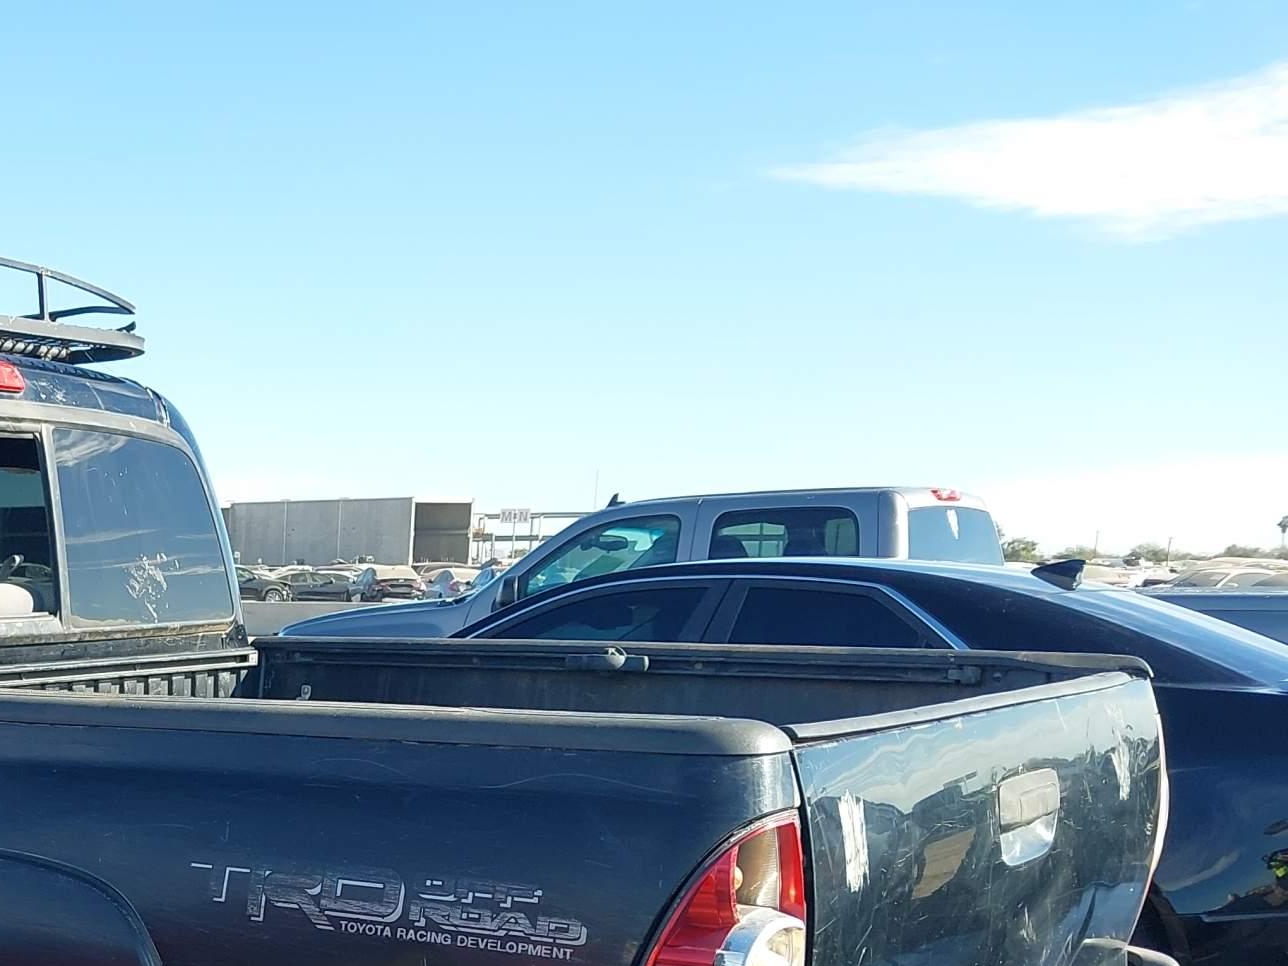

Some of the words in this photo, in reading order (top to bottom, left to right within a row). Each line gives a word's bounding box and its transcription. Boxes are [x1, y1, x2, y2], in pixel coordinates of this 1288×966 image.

[339, 920, 392, 940] TOYOTA
[396, 926, 452, 945] RACING
[457, 935, 575, 961] DEVELOPMENT
[409, 901, 588, 947] ROAD
